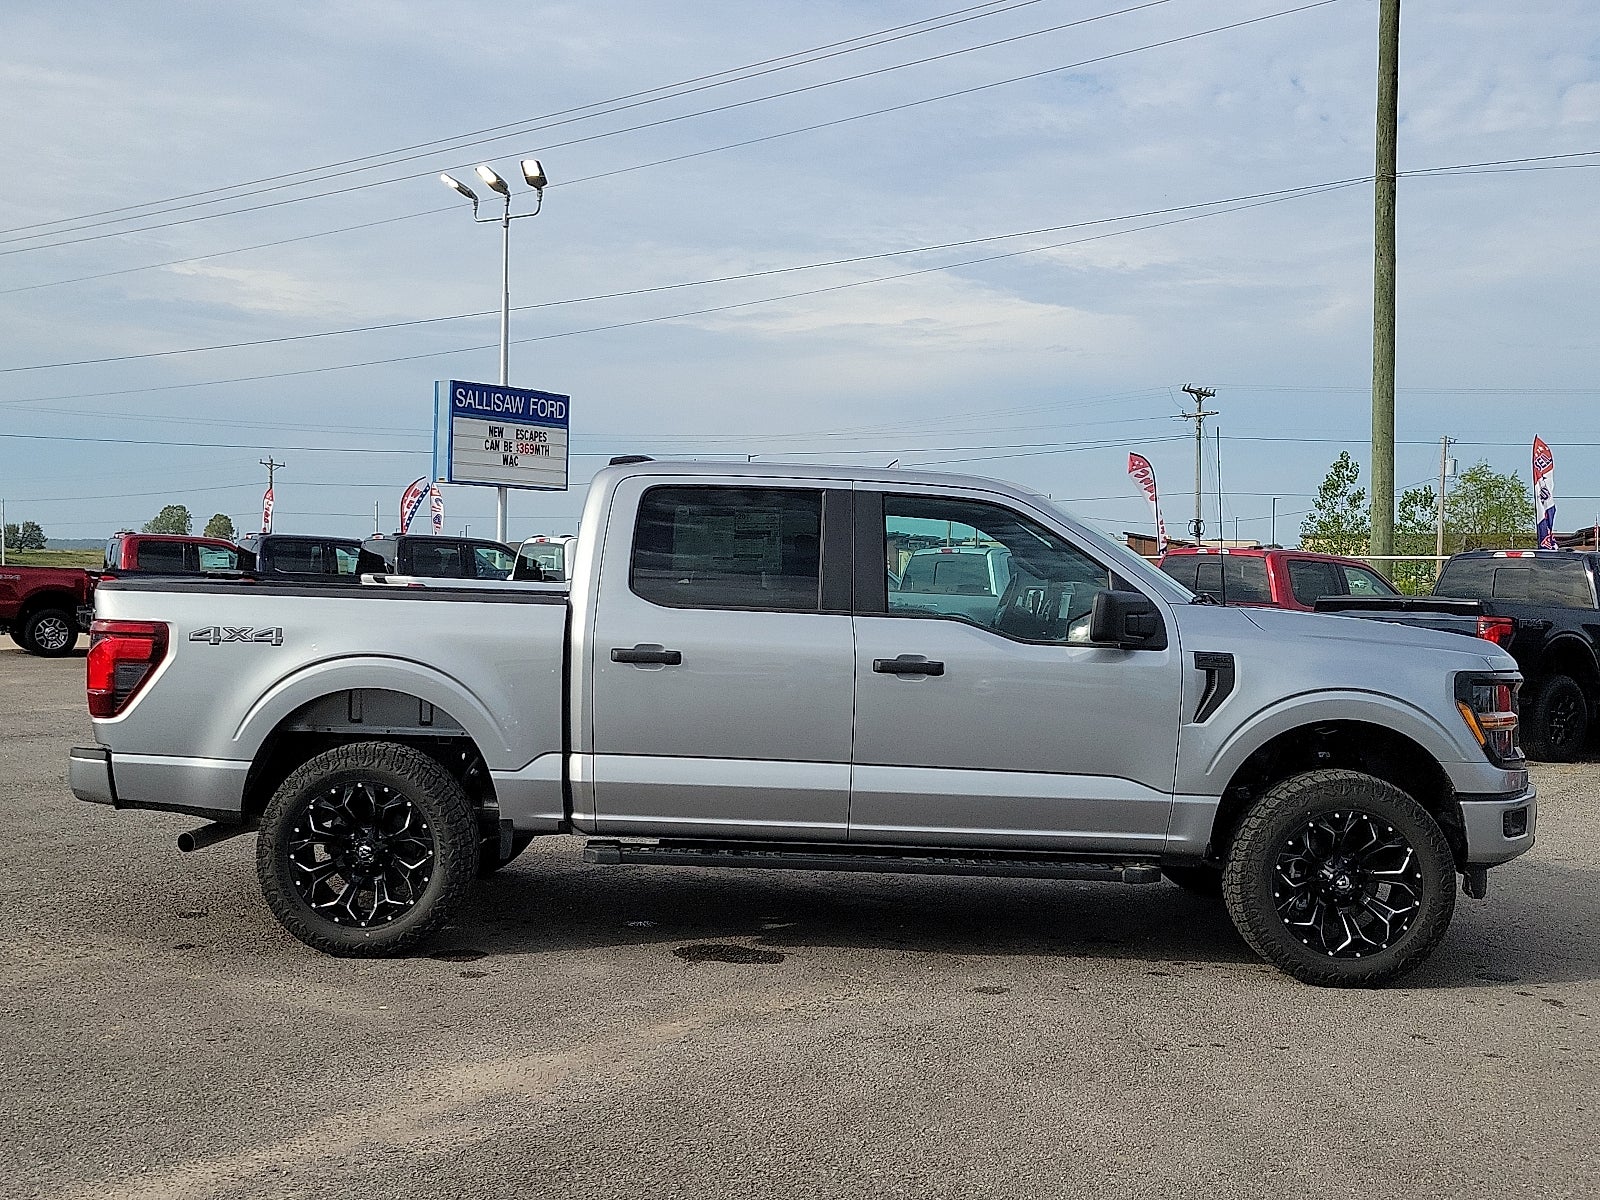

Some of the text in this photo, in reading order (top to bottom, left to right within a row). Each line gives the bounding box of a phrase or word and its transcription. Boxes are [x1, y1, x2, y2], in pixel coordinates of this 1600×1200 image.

[456, 389, 566, 418] SALLISAW FORD
[488, 425, 548, 443] NEW ESCAPES
[484, 439, 500, 452] CAN
[503, 441, 513, 453] BE
[502, 454, 519, 467] WAC
